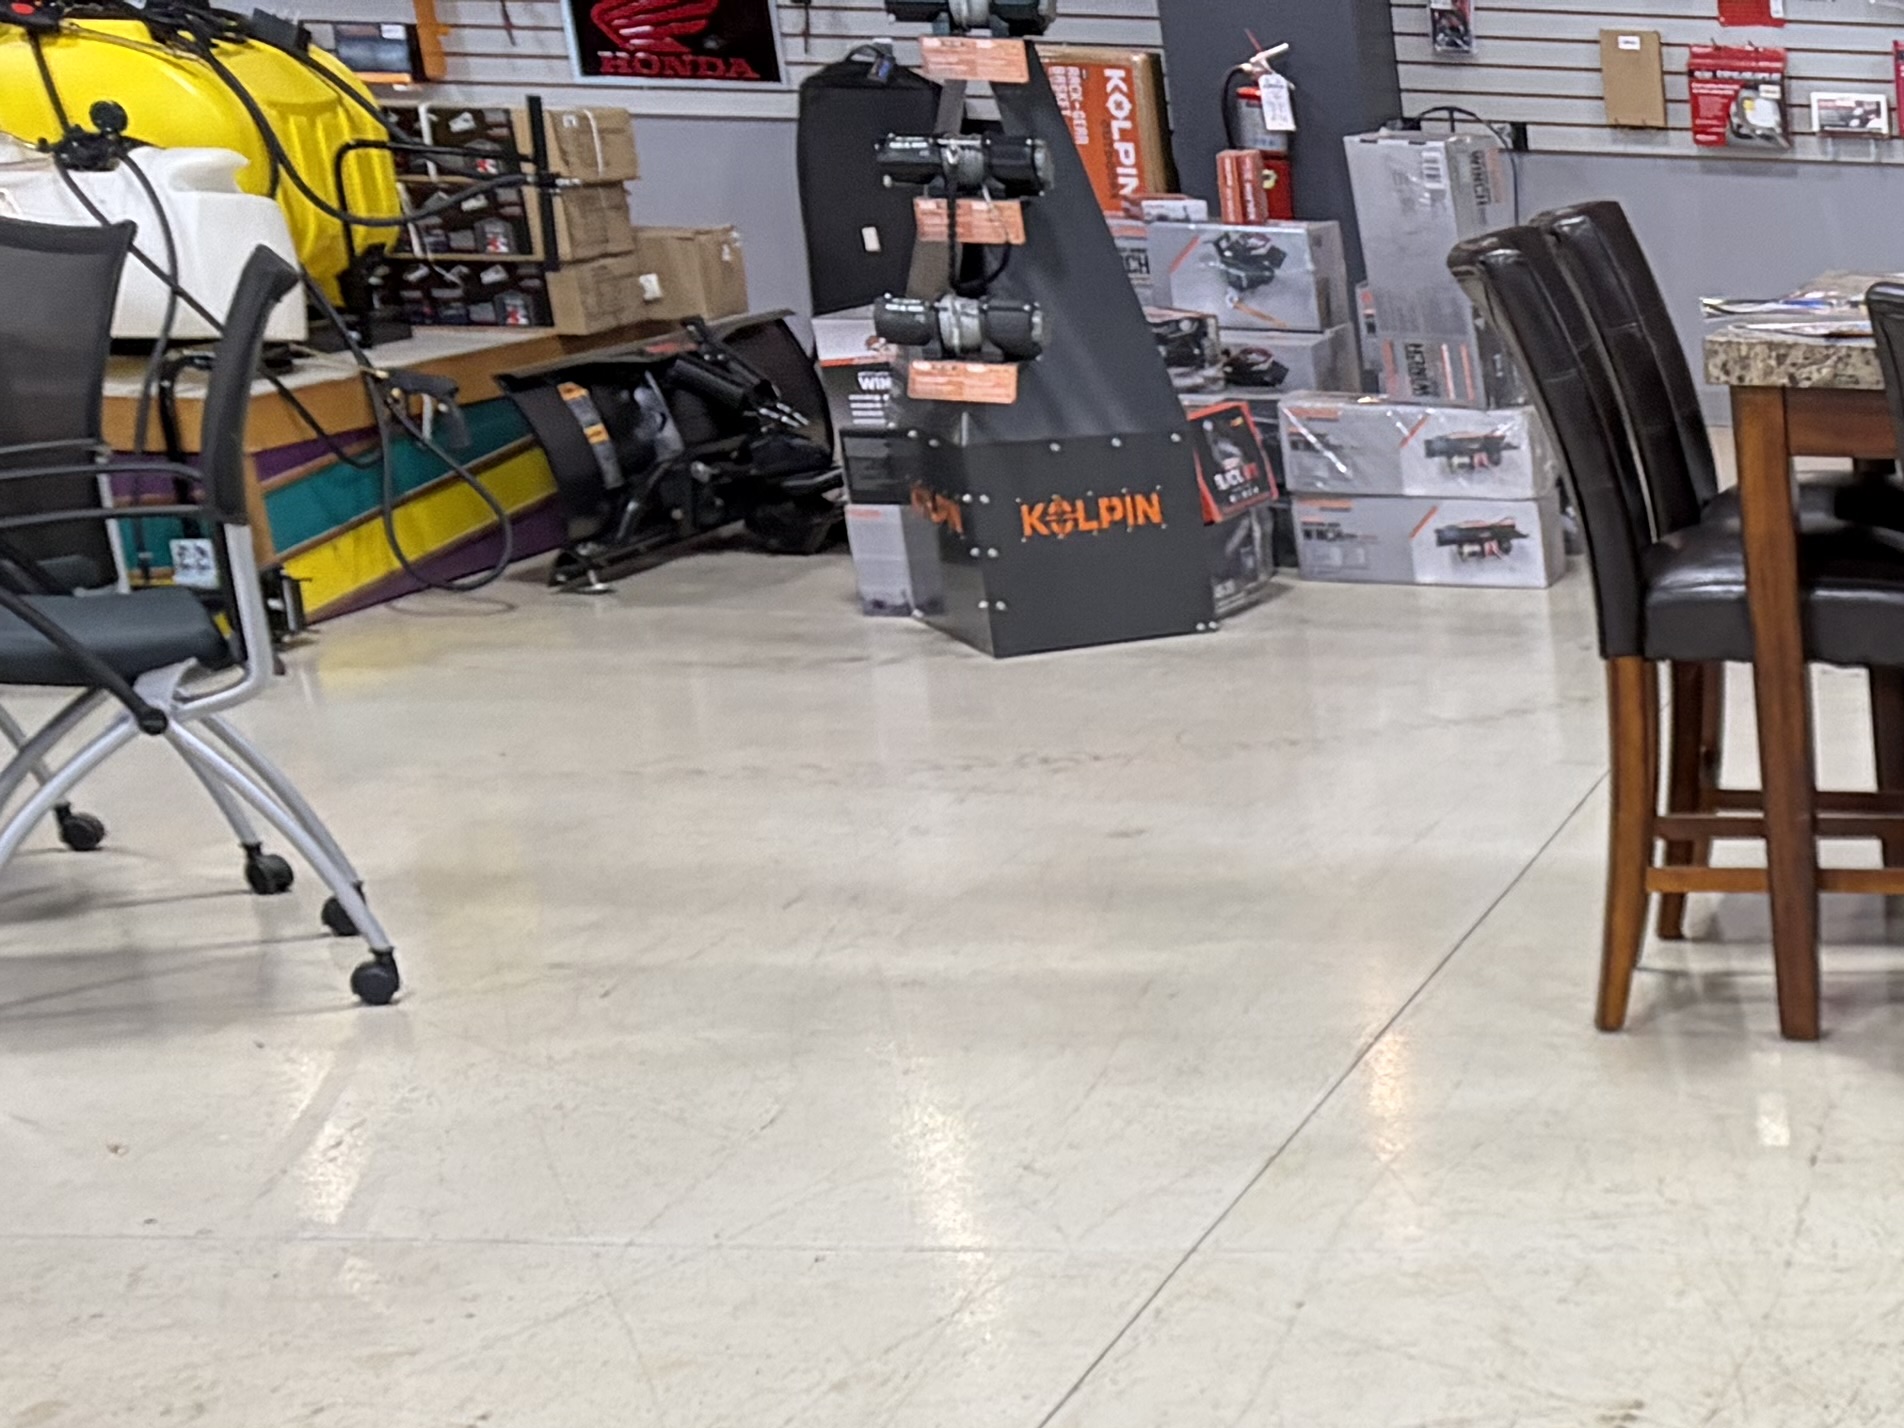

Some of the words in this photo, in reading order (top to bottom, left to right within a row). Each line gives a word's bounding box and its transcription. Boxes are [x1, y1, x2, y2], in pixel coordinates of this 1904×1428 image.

[597, 50, 761, 79] HONDA
[1103, 68, 1140, 196] KOLPIN
[1019, 491, 1162, 538] KOLPIN
